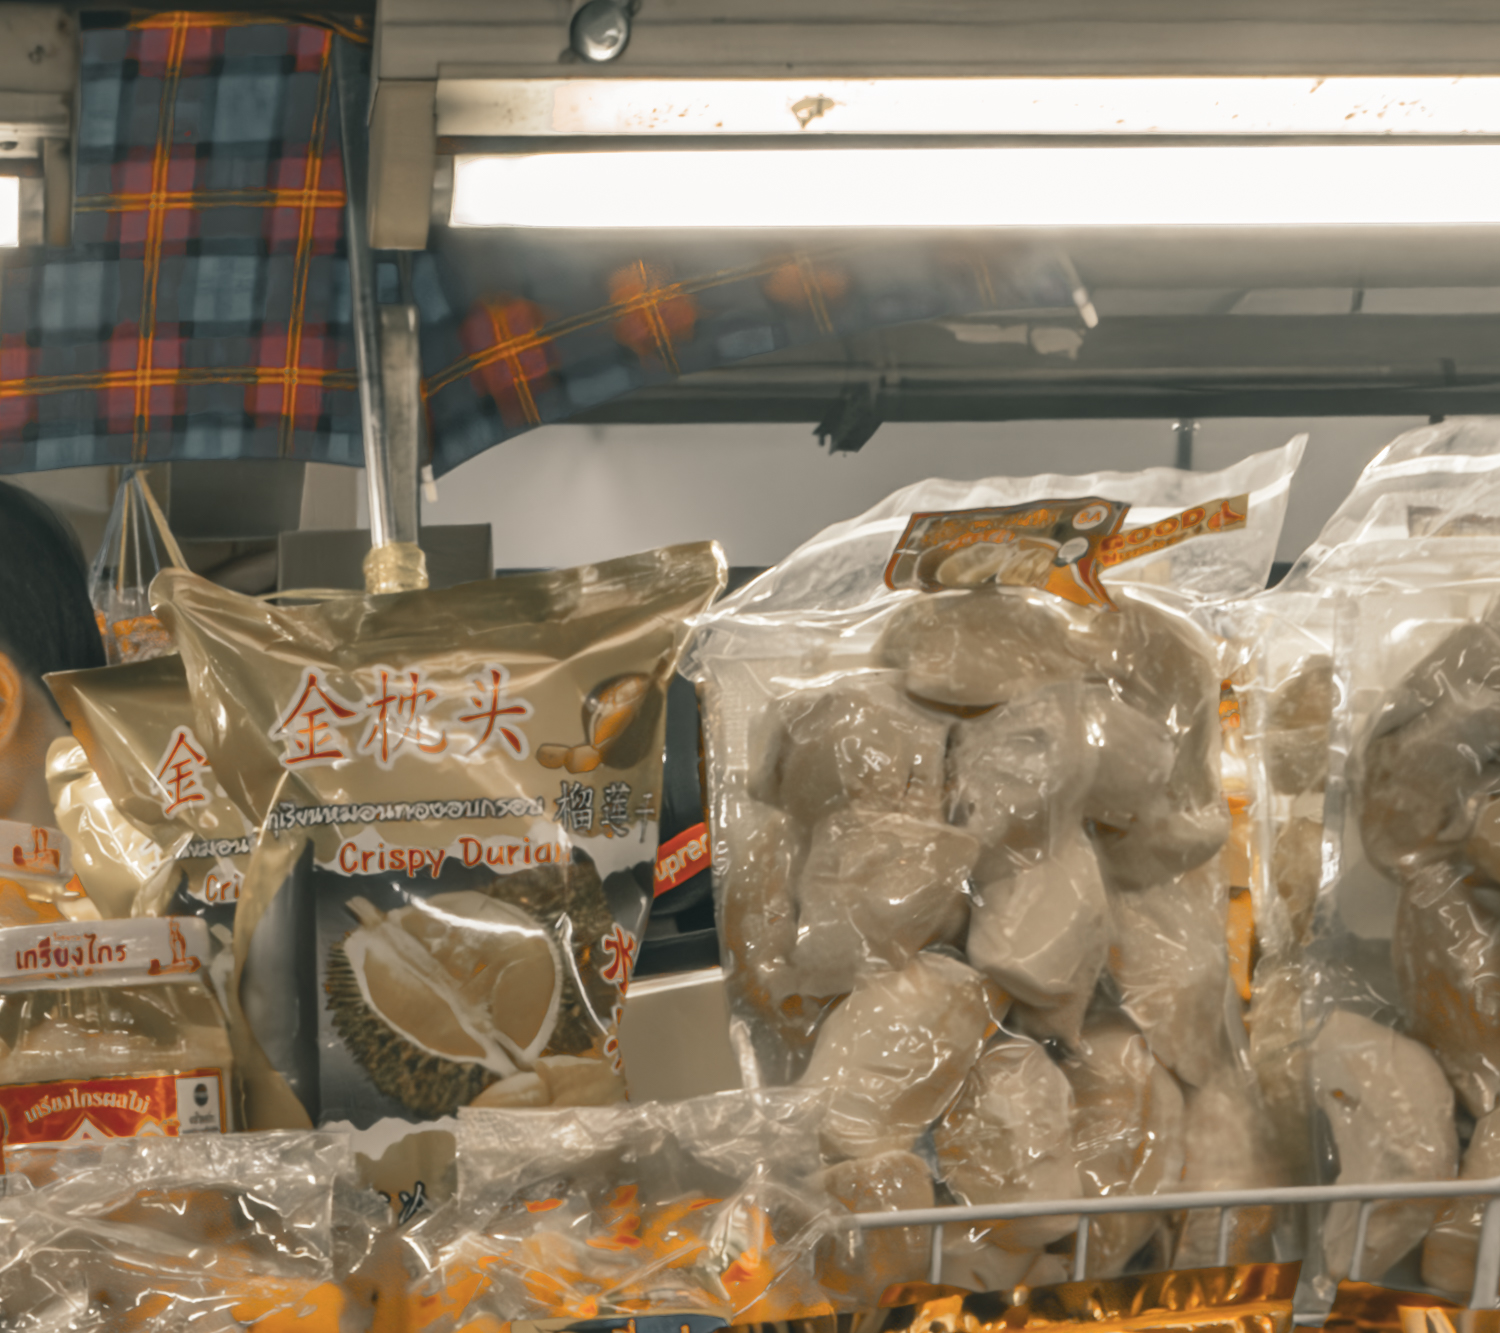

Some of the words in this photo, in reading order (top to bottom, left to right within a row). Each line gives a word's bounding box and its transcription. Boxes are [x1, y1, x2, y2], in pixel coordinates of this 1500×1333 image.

[283, 668, 530, 770] 金枕头
[339, 836, 446, 880] Crispy
[461, 832, 570, 868] Duria
